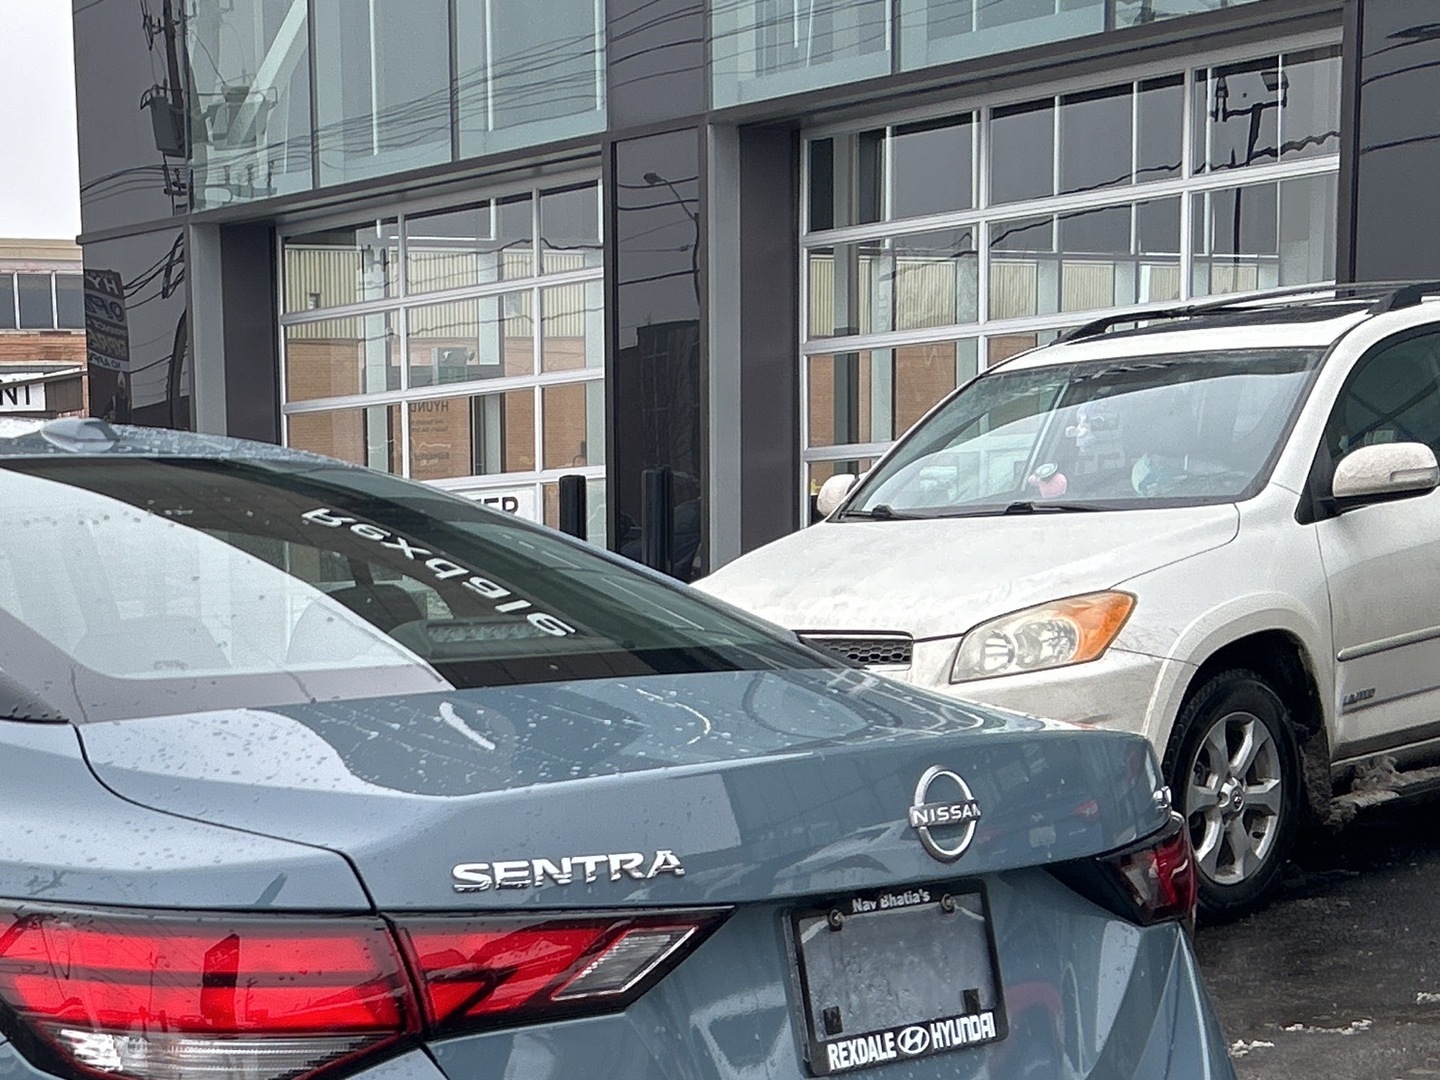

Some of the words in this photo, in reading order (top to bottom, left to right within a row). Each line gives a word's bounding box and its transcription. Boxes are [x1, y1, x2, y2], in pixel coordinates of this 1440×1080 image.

[912, 803, 981, 824] NISSAN
[452, 849, 686, 893] SENTRA
[852, 898, 877, 913] Nav
[880, 888, 931, 909] Bhatia's
[826, 1031, 897, 1071] REXDALE
[930, 1011, 997, 1049] HYUNDAI
